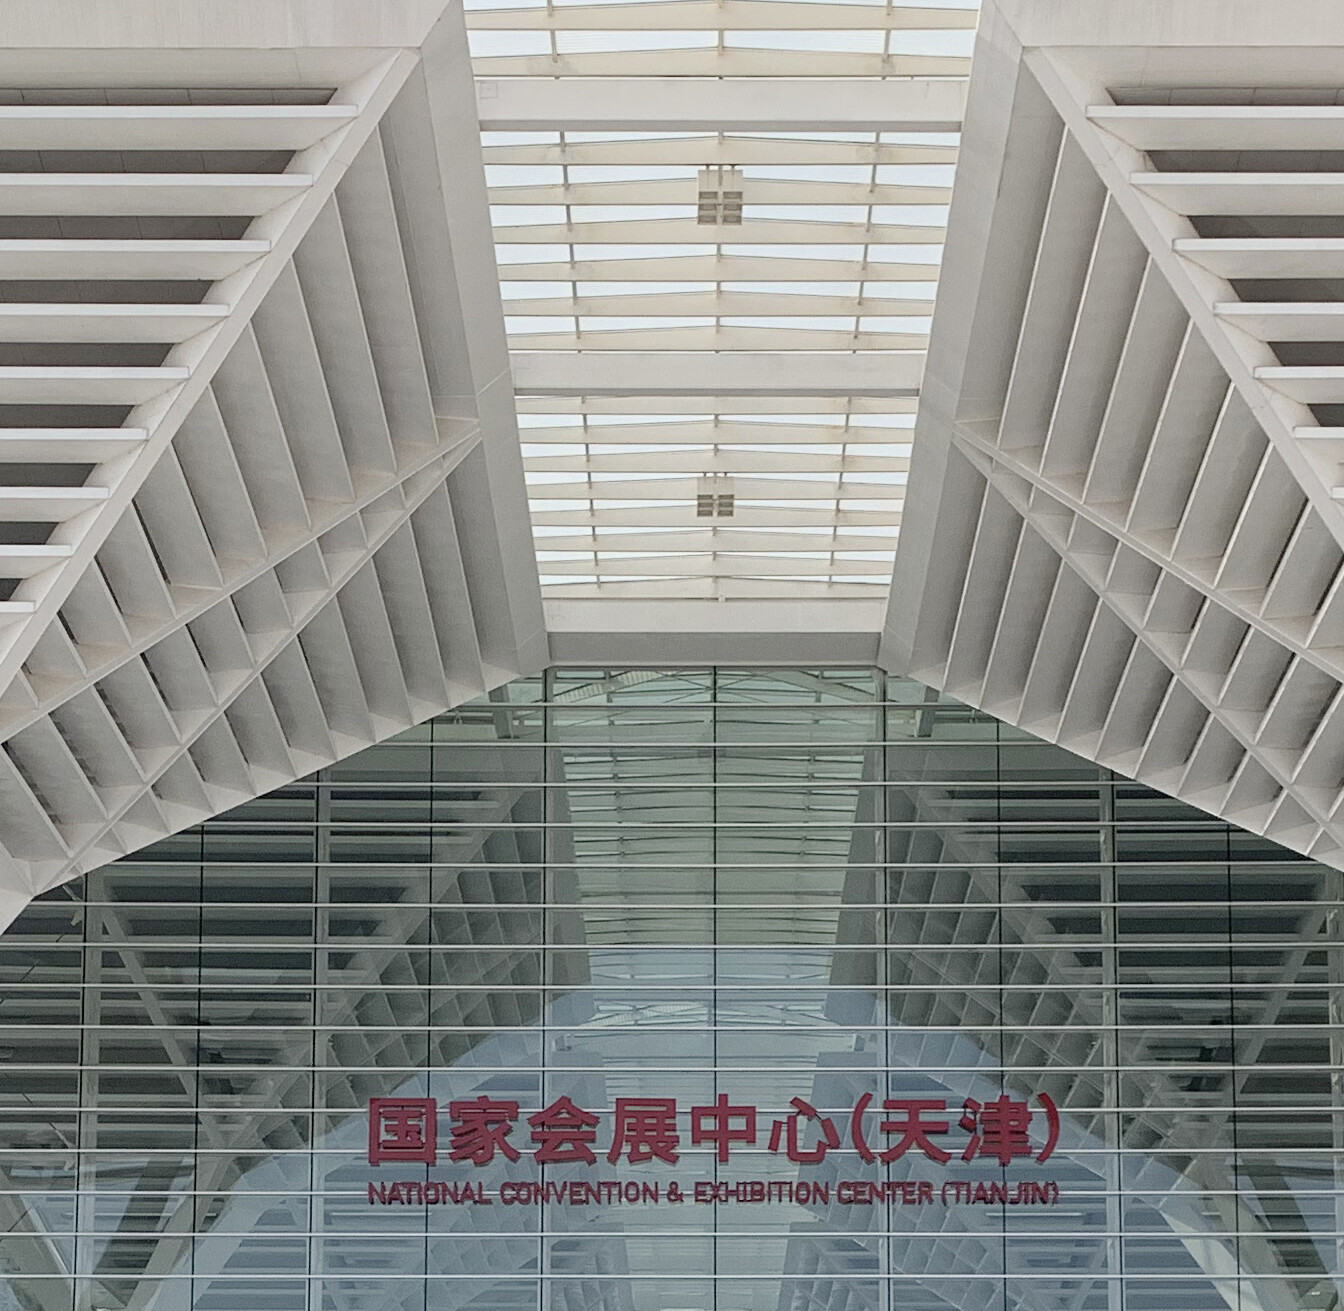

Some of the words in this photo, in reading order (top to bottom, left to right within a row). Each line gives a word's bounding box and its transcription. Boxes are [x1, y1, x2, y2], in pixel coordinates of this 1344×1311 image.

[369, 1092, 1060, 1167] 国家会展中心(天津)
[368, 1181, 492, 1206] NATIONAL
[500, 1181, 659, 1206] CONVENTION
[666, 1180, 684, 1204] &
[694, 1181, 830, 1205] EXHIBITION
[837, 1181, 935, 1206] CENTER
[942, 1181, 1059, 1207] (TIANJIN)
